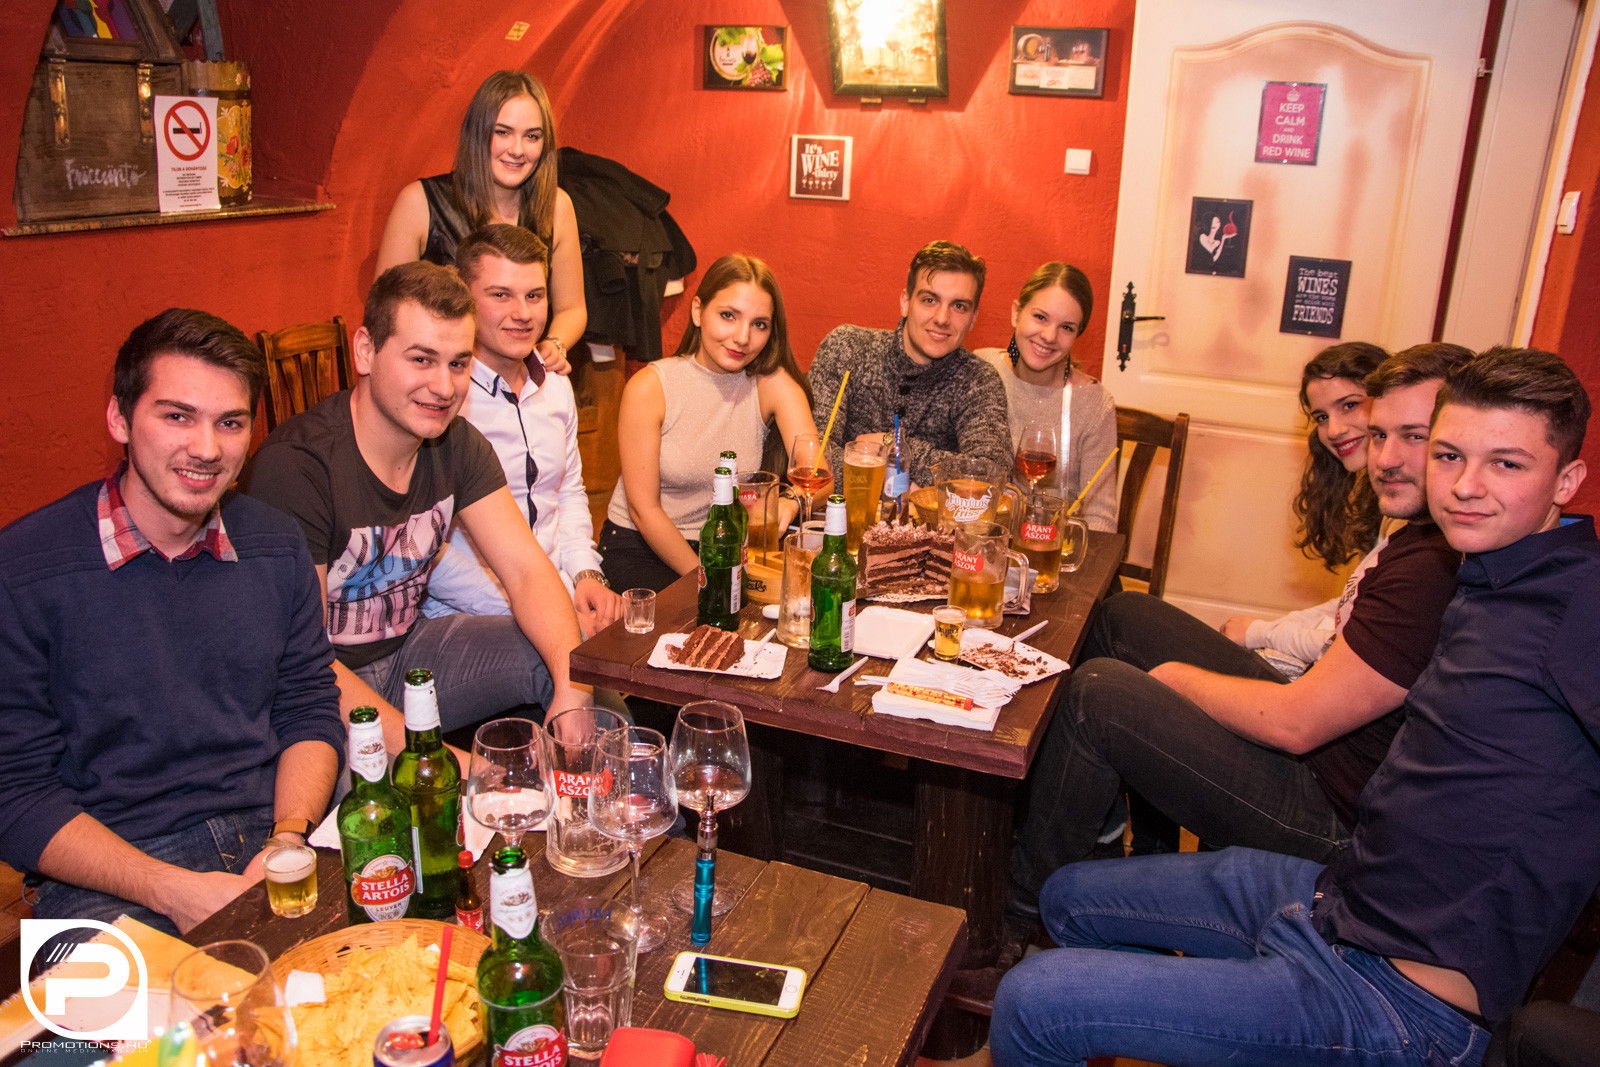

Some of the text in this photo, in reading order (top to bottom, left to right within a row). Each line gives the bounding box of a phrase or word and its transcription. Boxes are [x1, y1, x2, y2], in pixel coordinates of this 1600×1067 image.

[1279, 103, 1304, 113] KEEP
[1275, 115, 1306, 126] CALM
[1272, 134, 1304, 145] DRINK
[805, 144, 823, 153] It's
[1263, 146, 1311, 158] RED WINE
[801, 150, 839, 177] WINE
[1297, 276, 1339, 296] WINES
[1292, 304, 1335, 325] FRIENDS
[1026, 524, 1052, 533] ARANY
[361, 873, 409, 891] STELLA
[362, 881, 410, 900] ARTOIS
[376, 901, 402, 912] LEUVEN
[504, 1044, 560, 1067] STELLA
